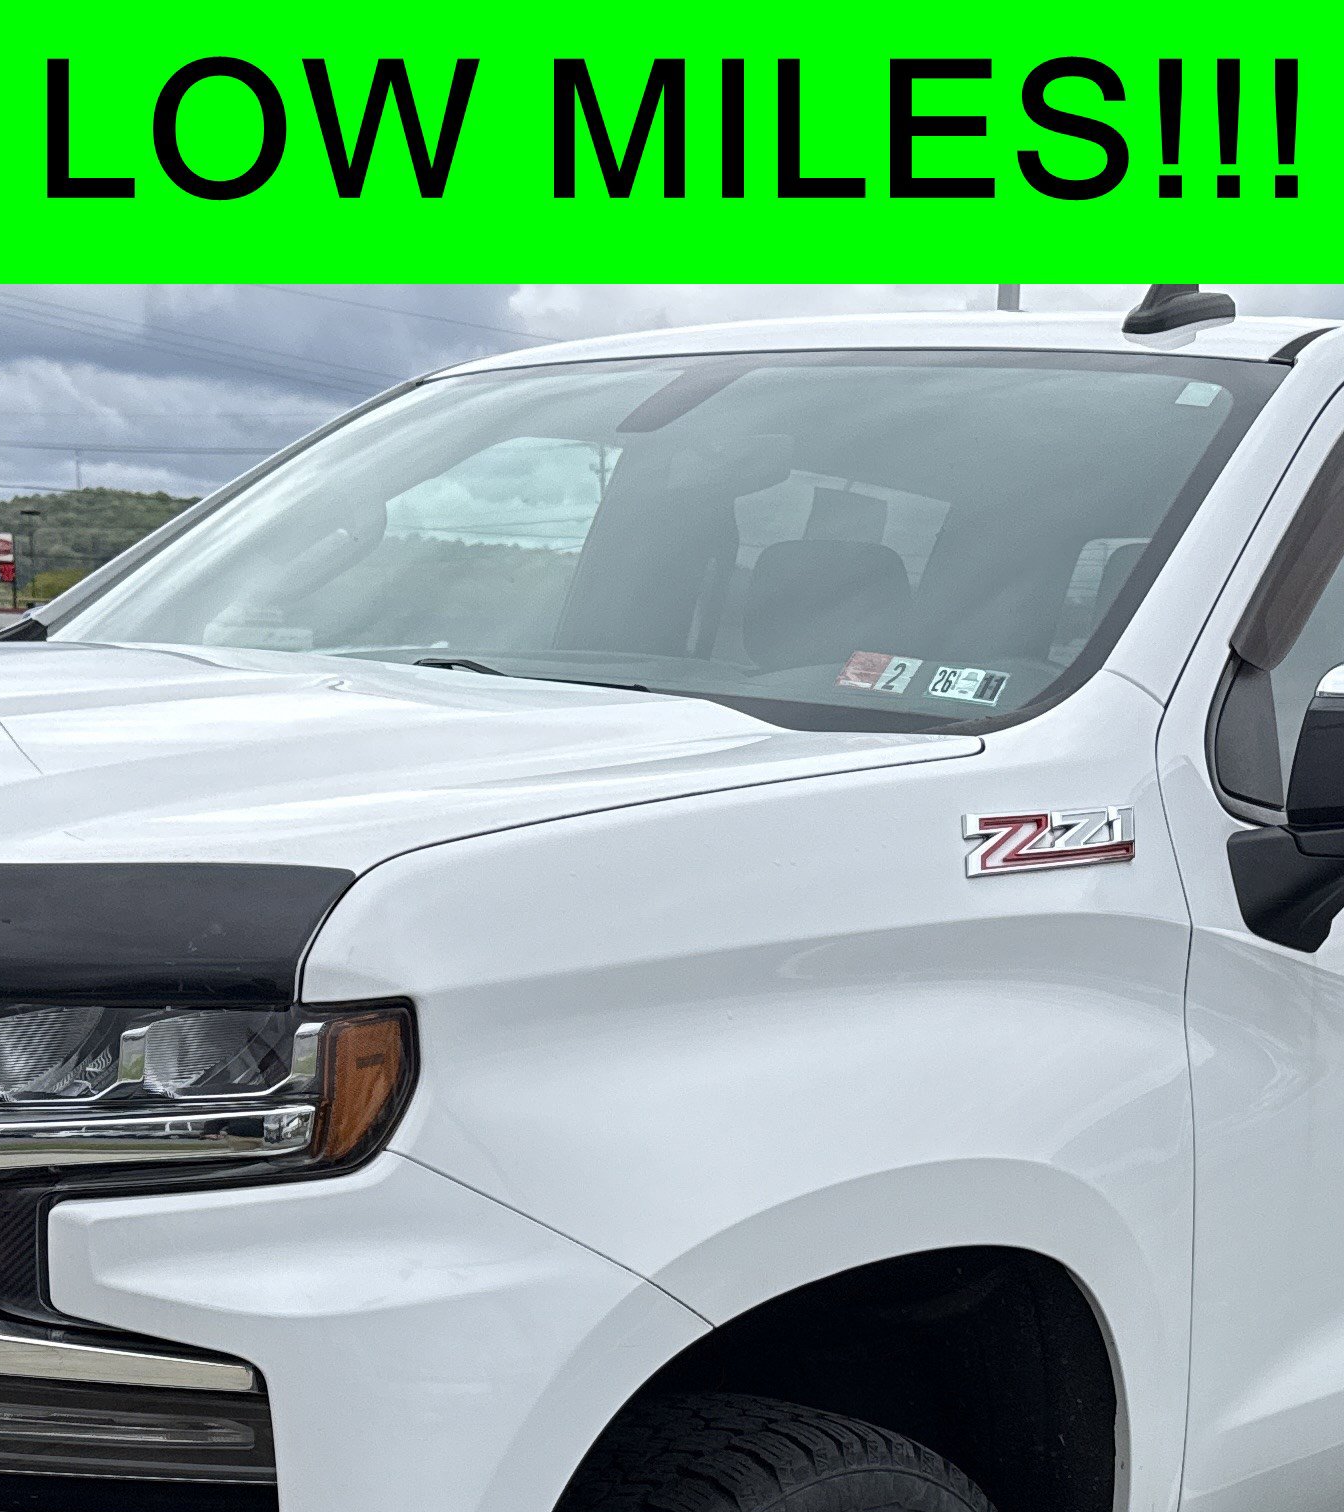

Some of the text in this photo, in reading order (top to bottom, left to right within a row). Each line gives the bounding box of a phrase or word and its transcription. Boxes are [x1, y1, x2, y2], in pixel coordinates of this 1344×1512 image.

[881, 662, 906, 690] 2
[931, 669, 1005, 701] 26 11
[961, 805, 1136, 879] Z71
